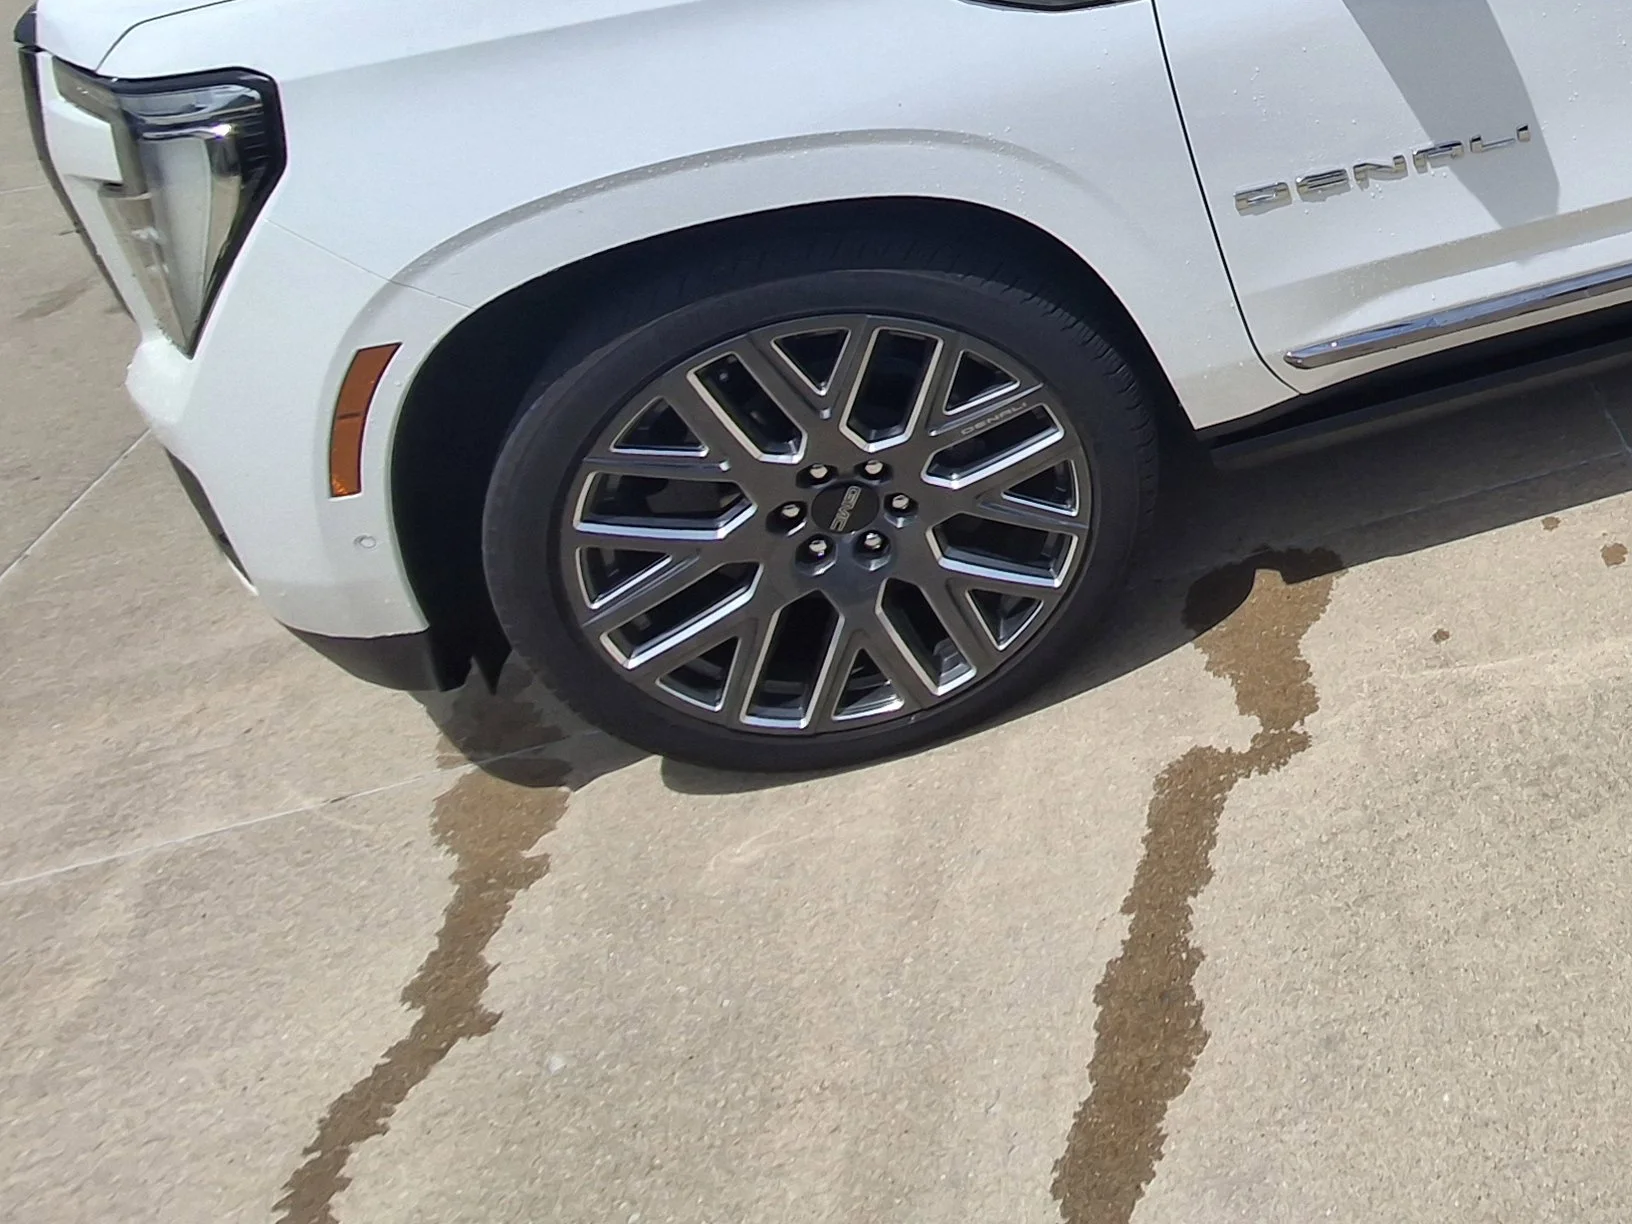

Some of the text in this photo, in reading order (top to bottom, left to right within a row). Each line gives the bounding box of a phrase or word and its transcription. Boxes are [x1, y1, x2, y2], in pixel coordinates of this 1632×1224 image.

[1233, 124, 1531, 213] DENALI
[961, 402, 1027, 435] DENALI
[829, 485, 862, 532] GMC
